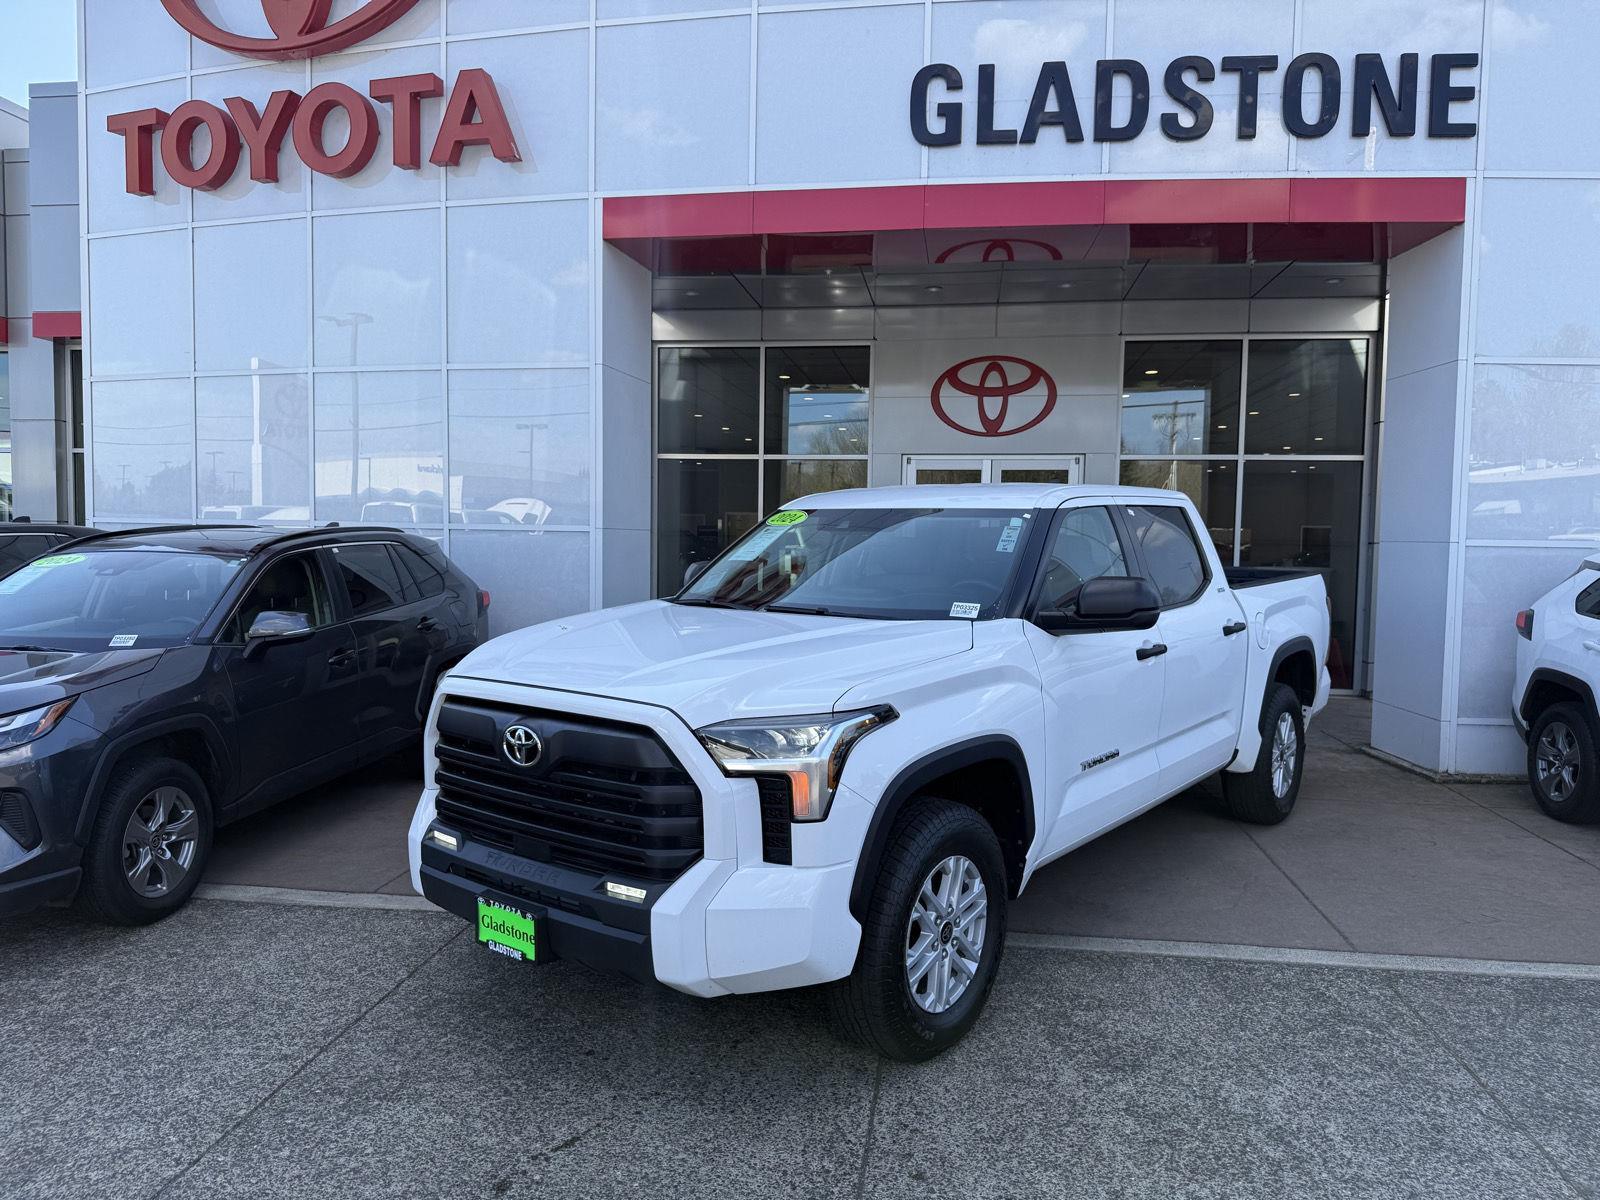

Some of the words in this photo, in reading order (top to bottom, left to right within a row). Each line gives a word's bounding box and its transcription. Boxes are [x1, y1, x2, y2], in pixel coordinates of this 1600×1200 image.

[909, 52, 1479, 147] GLADSTONE
[106, 68, 522, 197] TOYOTA
[488, 899, 522, 917] TOYOTA
[481, 914, 536, 946] Gladstone
[488, 940, 523, 961] GLADSTONE
